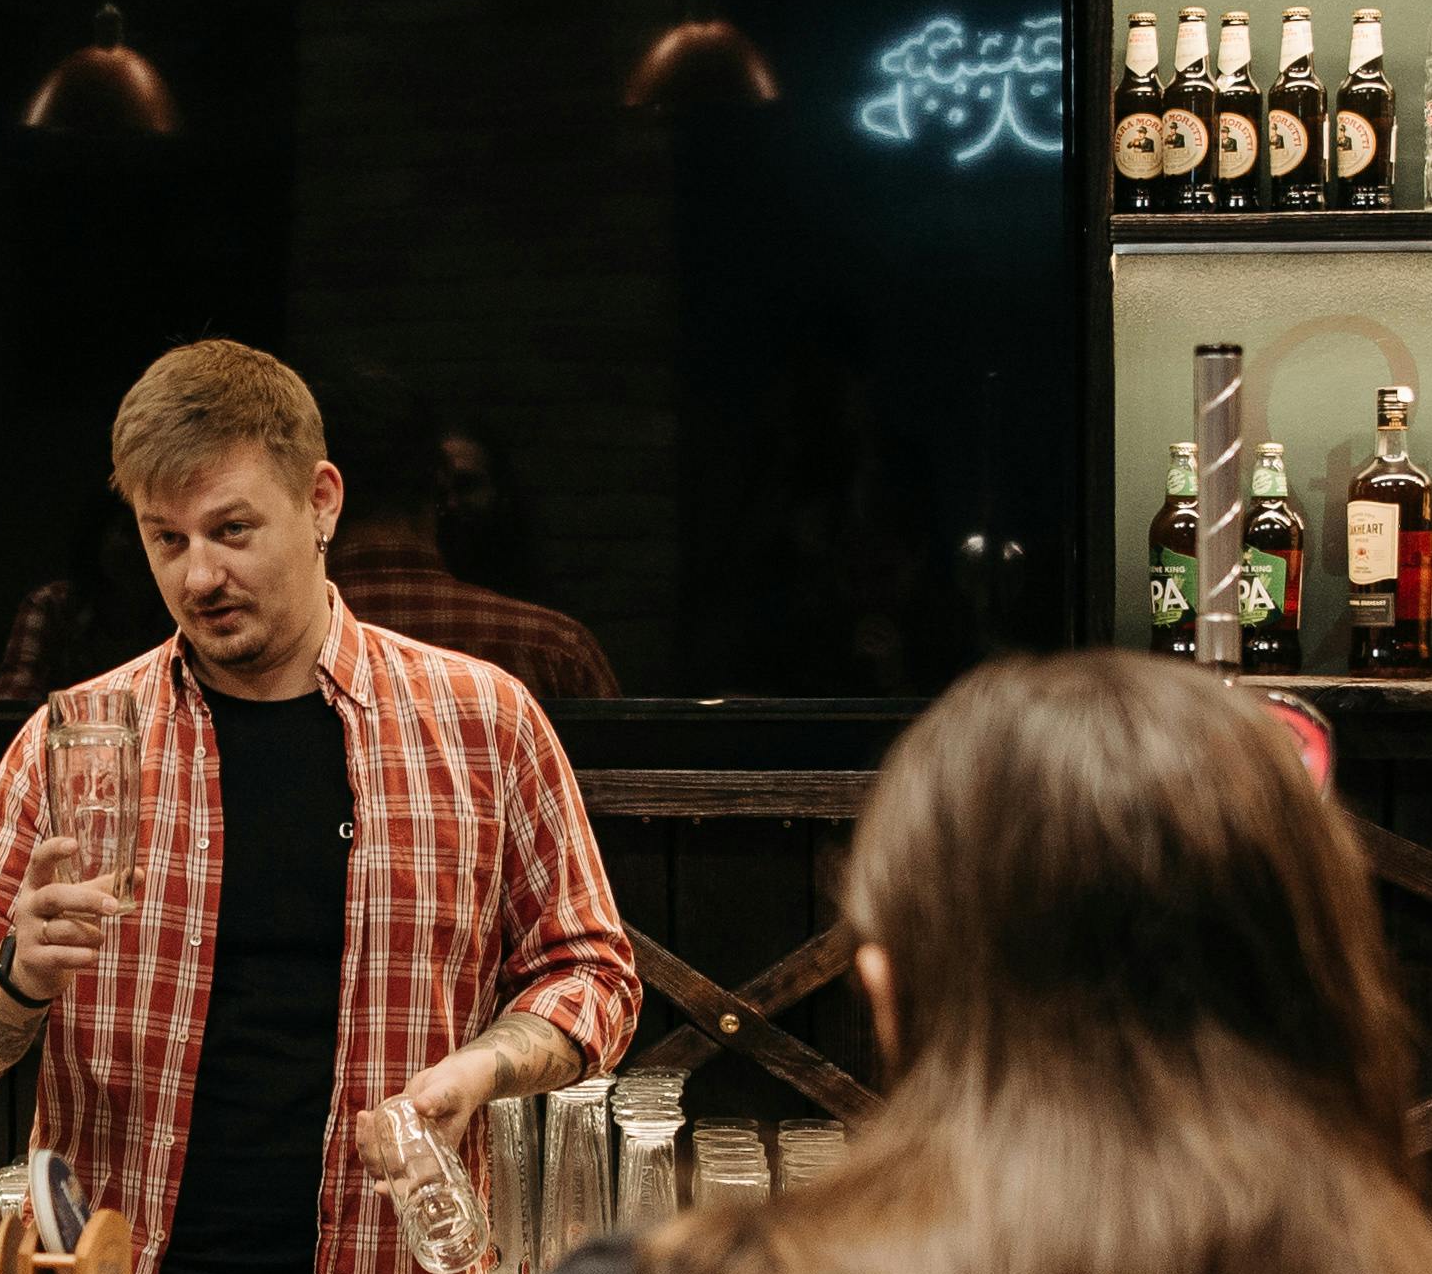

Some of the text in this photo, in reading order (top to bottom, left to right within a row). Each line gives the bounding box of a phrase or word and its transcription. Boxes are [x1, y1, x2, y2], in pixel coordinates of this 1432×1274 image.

[1168, 114, 1203, 148] MORETTI
[1220, 117, 1253, 152] MORETTI
[1270, 114, 1302, 148] MORETTI
[1338, 115, 1370, 151] MORETTI
[1349, 522, 1384, 536] AKHEART
[1164, 565, 1186, 573] KING
[1251, 564, 1273, 573] KING
[1150, 577, 1190, 614] PA
[1238, 576, 1276, 613] PA
